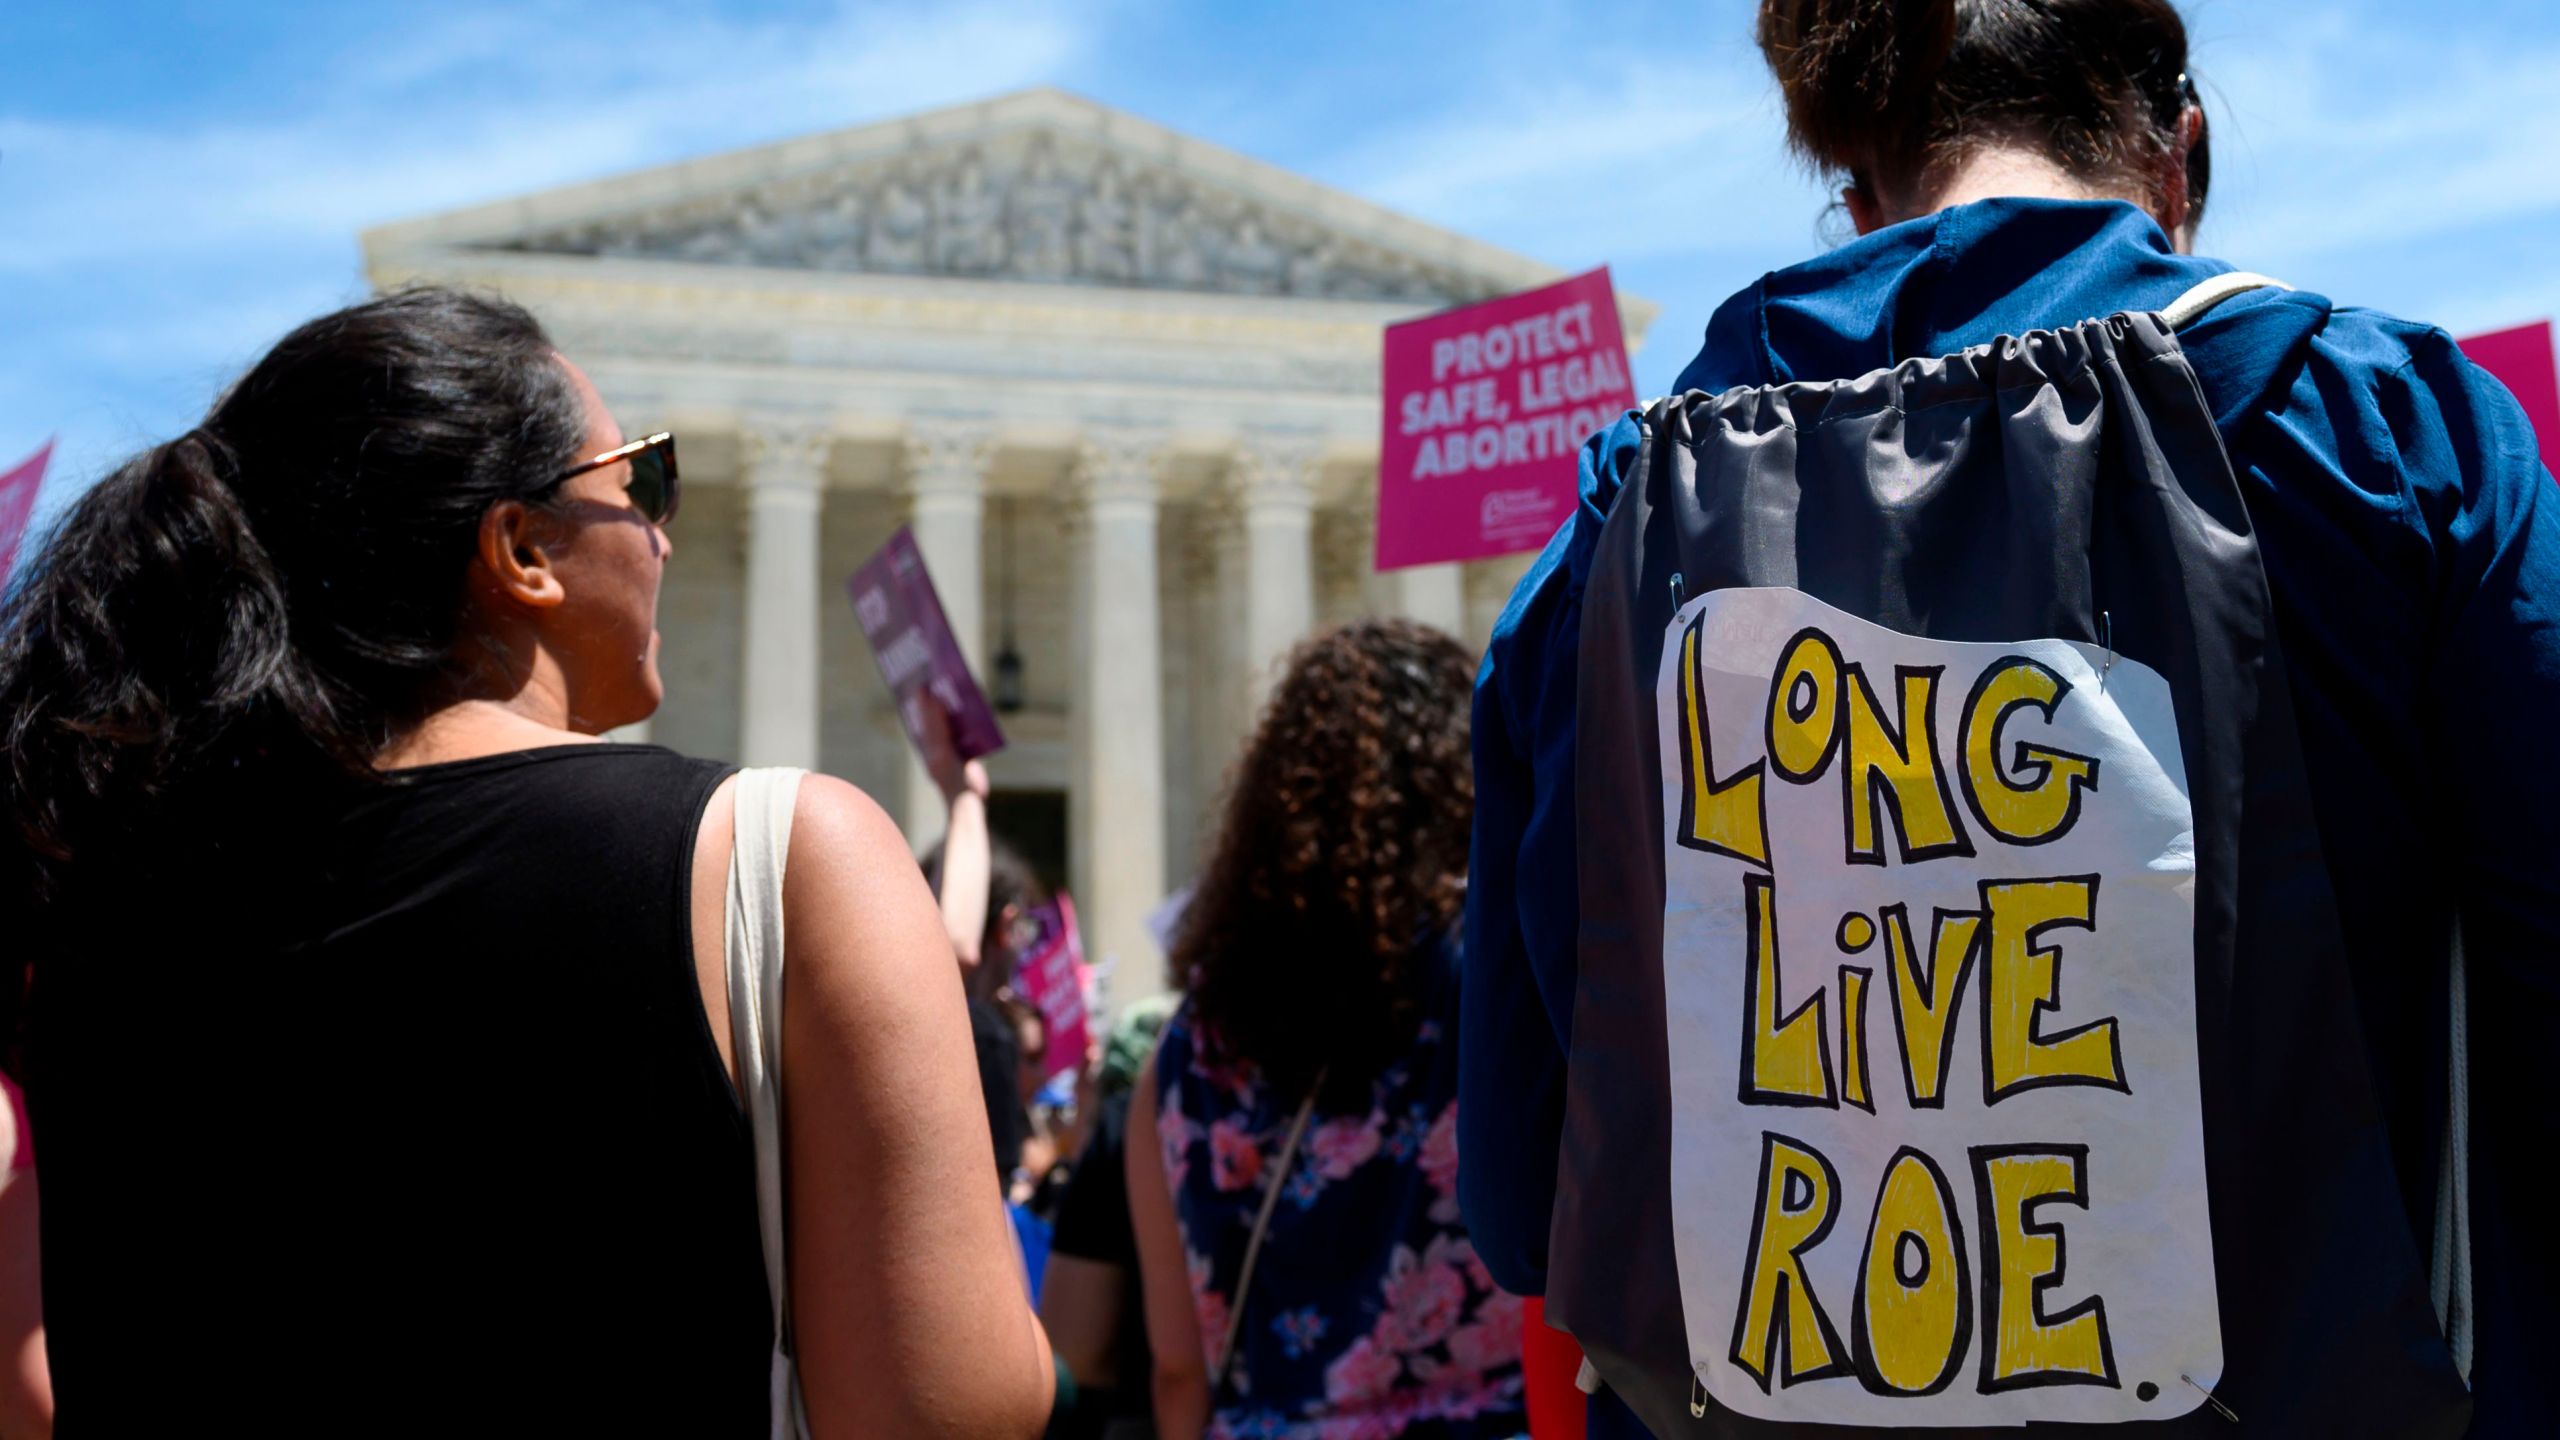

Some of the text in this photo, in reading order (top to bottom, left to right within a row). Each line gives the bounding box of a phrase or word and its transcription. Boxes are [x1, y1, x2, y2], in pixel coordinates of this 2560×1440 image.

[1430, 302, 1594, 382] PROTECT
[1400, 348, 1626, 436] SAFE, LEGAL
[1676, 606, 2099, 874] LONG
